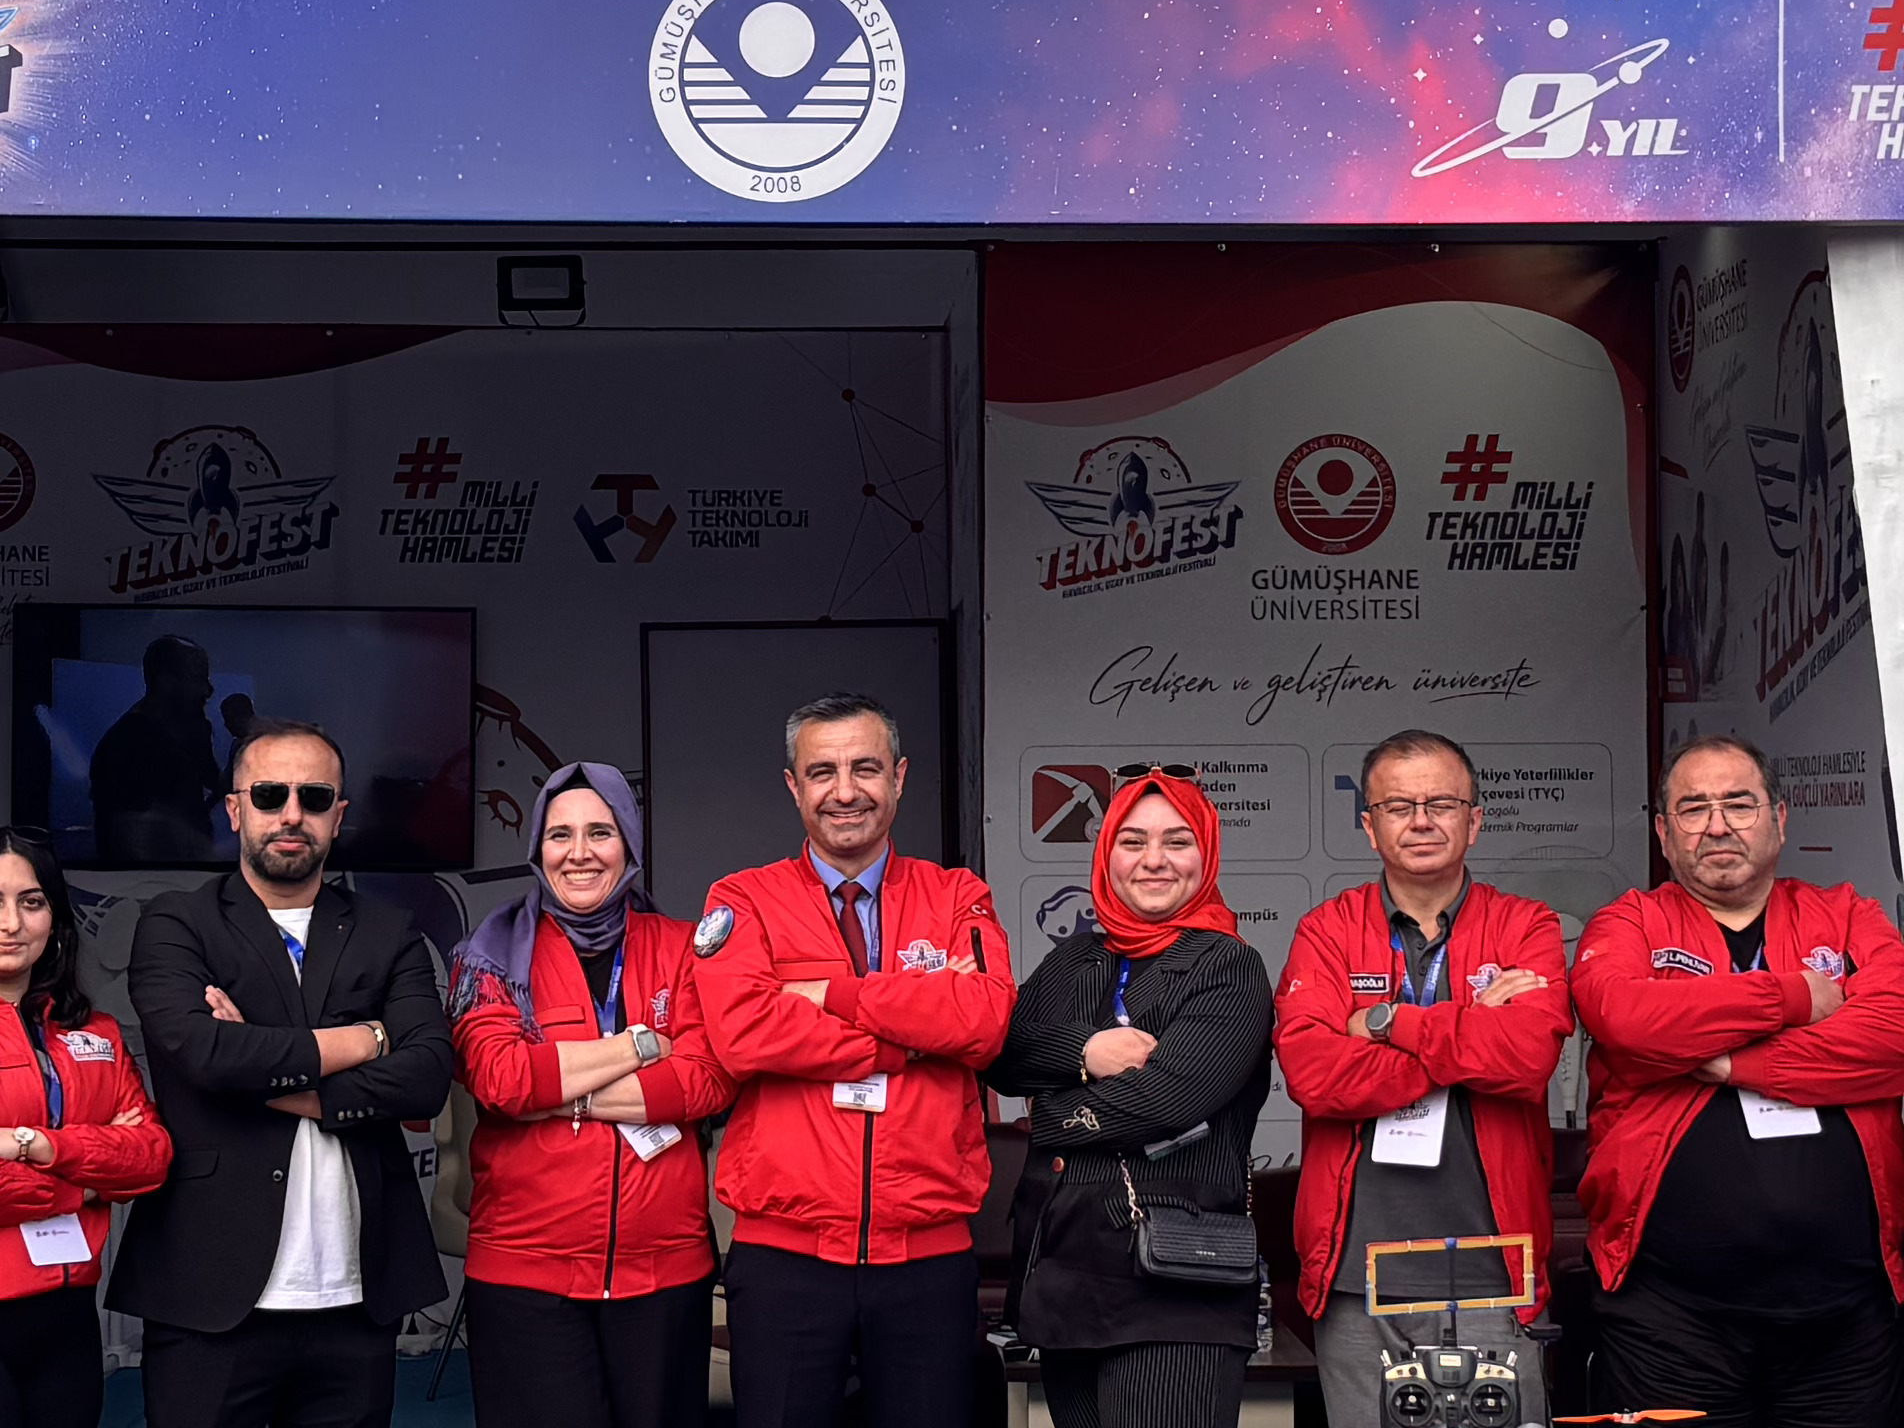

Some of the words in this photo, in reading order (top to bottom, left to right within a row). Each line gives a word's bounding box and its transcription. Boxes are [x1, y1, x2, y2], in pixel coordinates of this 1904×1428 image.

[749, 175, 802, 193] 2008
[104, 501, 340, 594] TEKNOFEST
[687, 530, 760, 548] TAKIMI
[1036, 504, 1244, 591] TEKNOFEST
[1251, 567, 1419, 595] GÜMÜŞHANE
[1250, 597, 1419, 620] ÜNİVERSİTESİ
[1089, 646, 1221, 718] Gelişen
[1233, 676, 1252, 691] ve
[1246, 644, 1397, 726] geliştiren
[1413, 658, 1540, 695] üniversite
[1201, 761, 1268, 774] Kalkınma
[1528, 787, 1565, 802] (TYÇ)
[1516, 821, 1579, 834] Programlar
